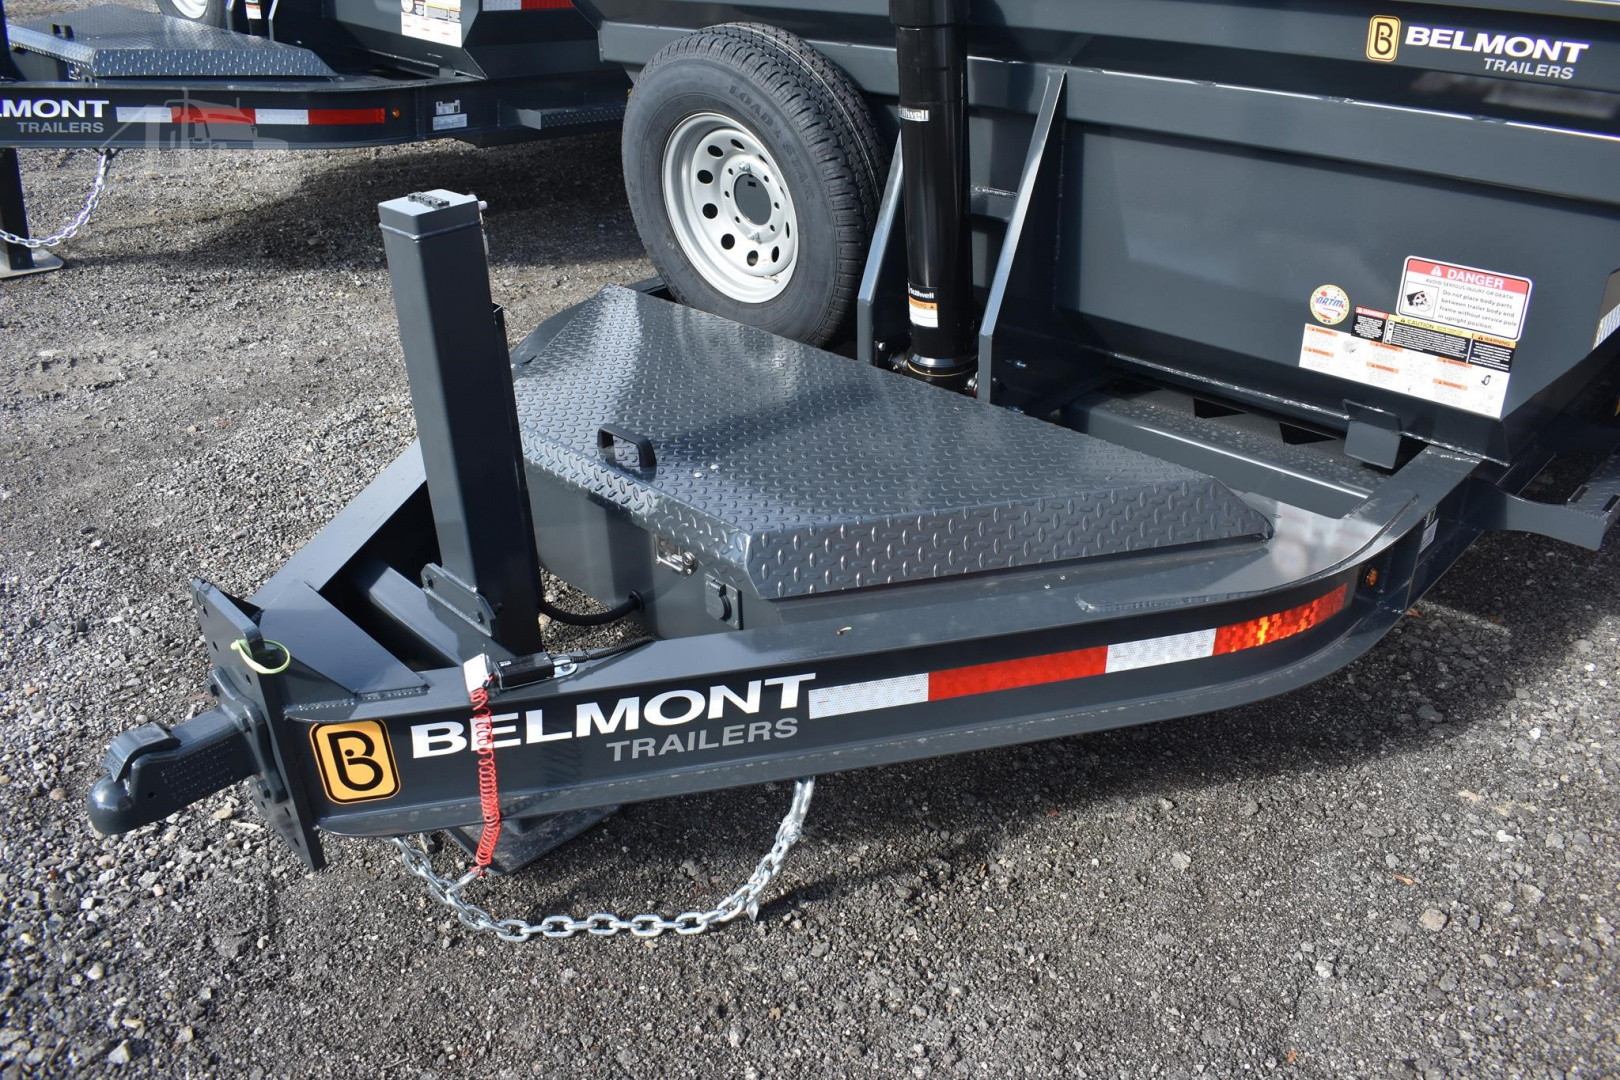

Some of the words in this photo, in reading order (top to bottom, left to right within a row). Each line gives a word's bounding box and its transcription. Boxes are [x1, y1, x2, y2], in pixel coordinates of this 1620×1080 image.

[1405, 26, 1589, 63] BELMONT
[1484, 57, 1574, 80] TRAILERS
[0, 99, 109, 118] MONT
[17, 122, 104, 133] TRAILERS
[1447, 269, 1504, 289] DANGER
[1443, 282, 1465, 290] SERIOUS
[1495, 292, 1513, 300] DEATH
[1441, 298, 1466, 308] between
[1467, 303, 1485, 311] trailer
[1486, 307, 1502, 315] body
[1463, 294, 1479, 303] place
[1480, 298, 1495, 306] body
[1407, 320, 1435, 329] CAUTION
[1445, 315, 1466, 325] upright
[1458, 310, 1481, 319] without
[1481, 315, 1502, 323] service
[1484, 336, 1511, 346] WARNING
[410, 672, 817, 759] BELMONT
[606, 717, 799, 762] TRAILERS
